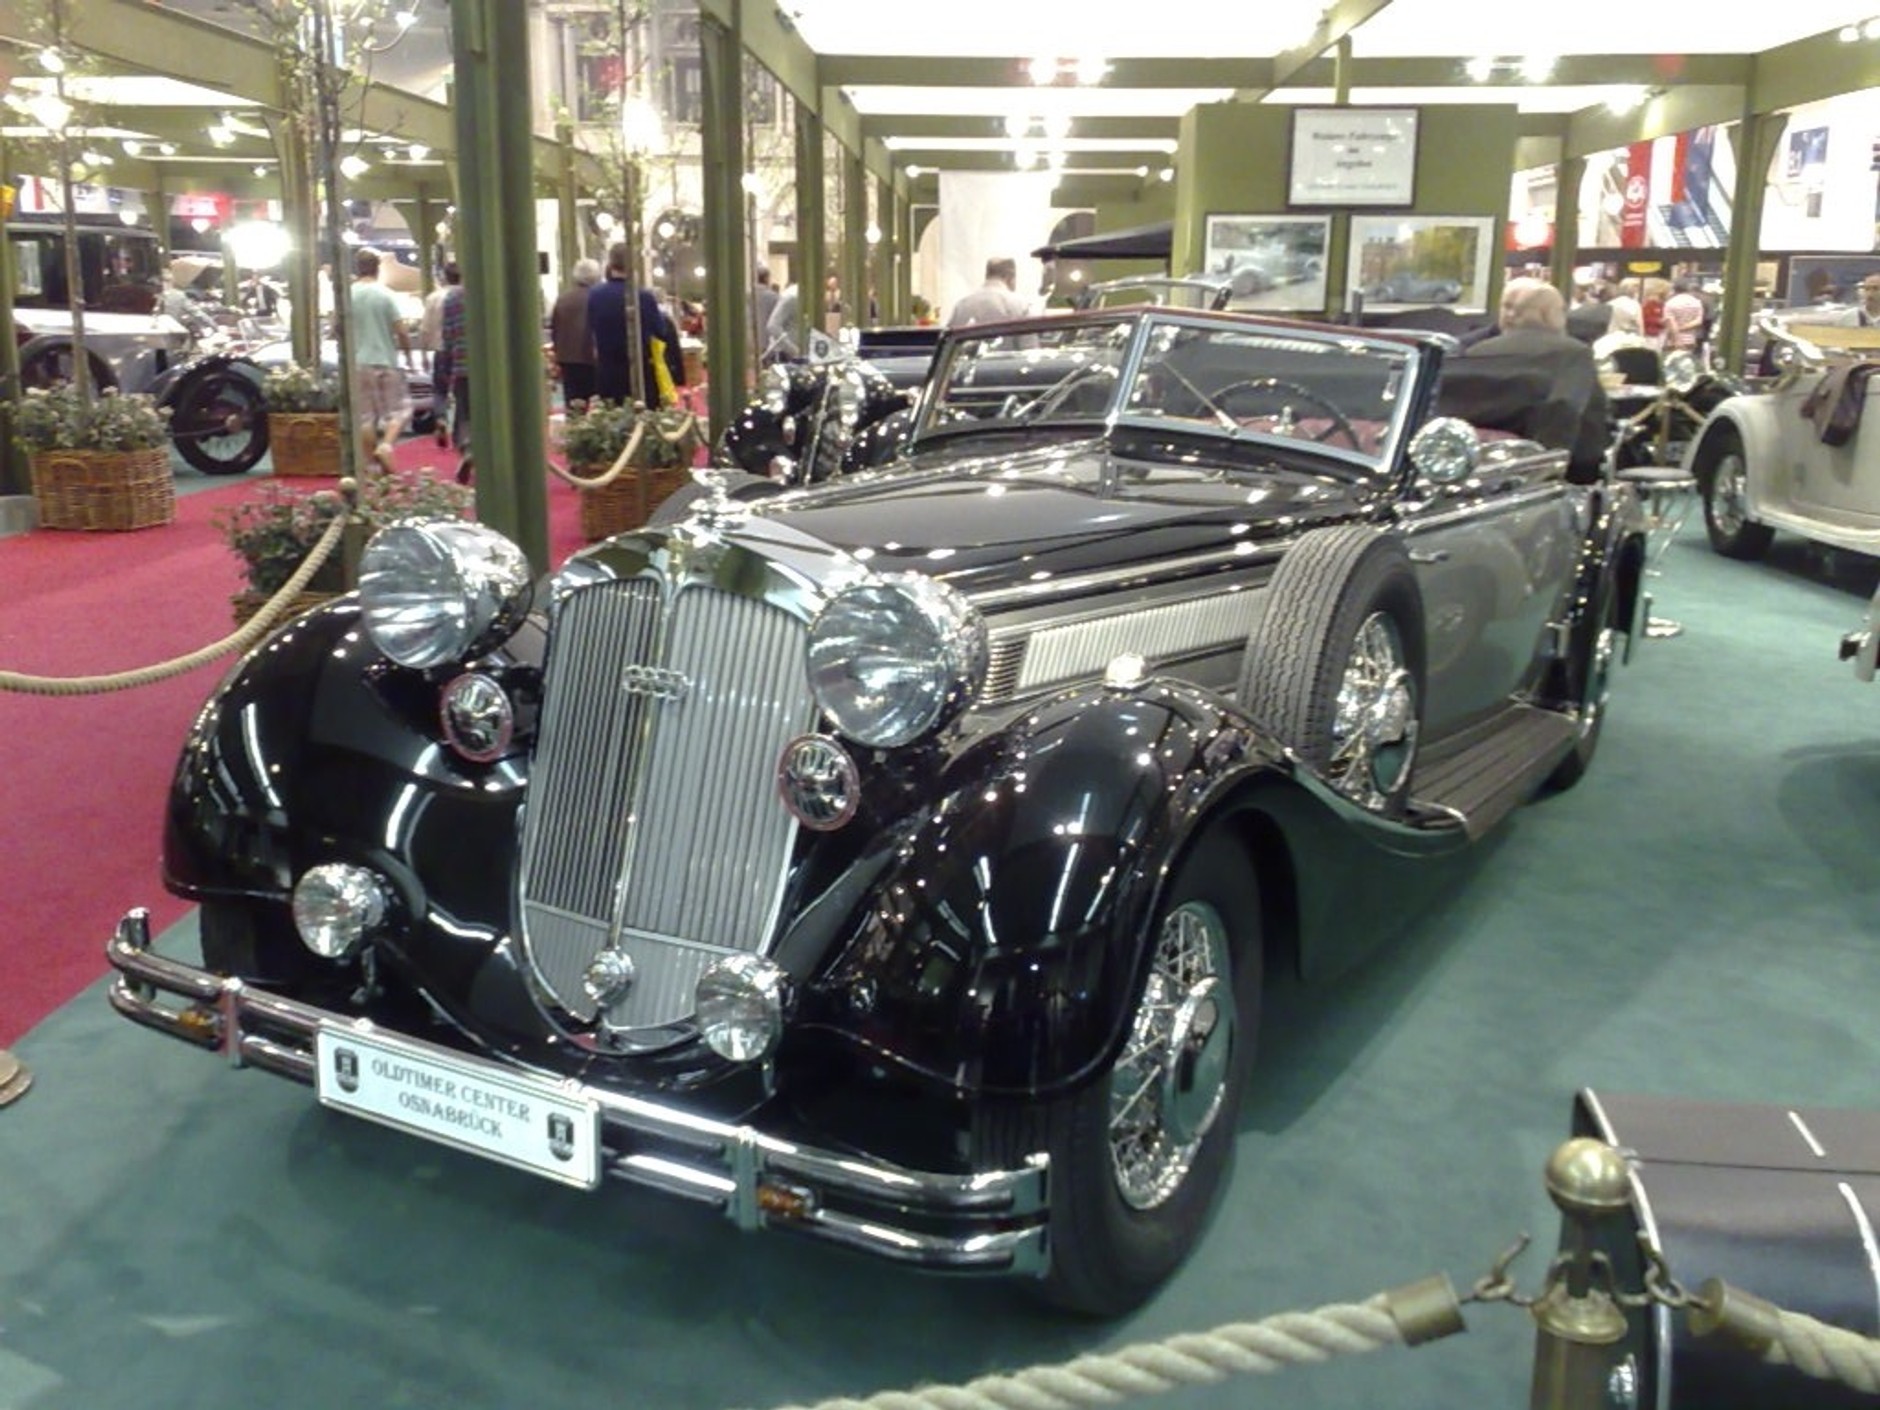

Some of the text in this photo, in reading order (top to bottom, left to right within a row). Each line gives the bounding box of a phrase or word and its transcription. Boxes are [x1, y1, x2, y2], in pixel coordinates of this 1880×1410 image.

[371, 1058, 531, 1123] OLDTIMER CENTER
[398, 1091, 503, 1139] OSNABRÜCK
